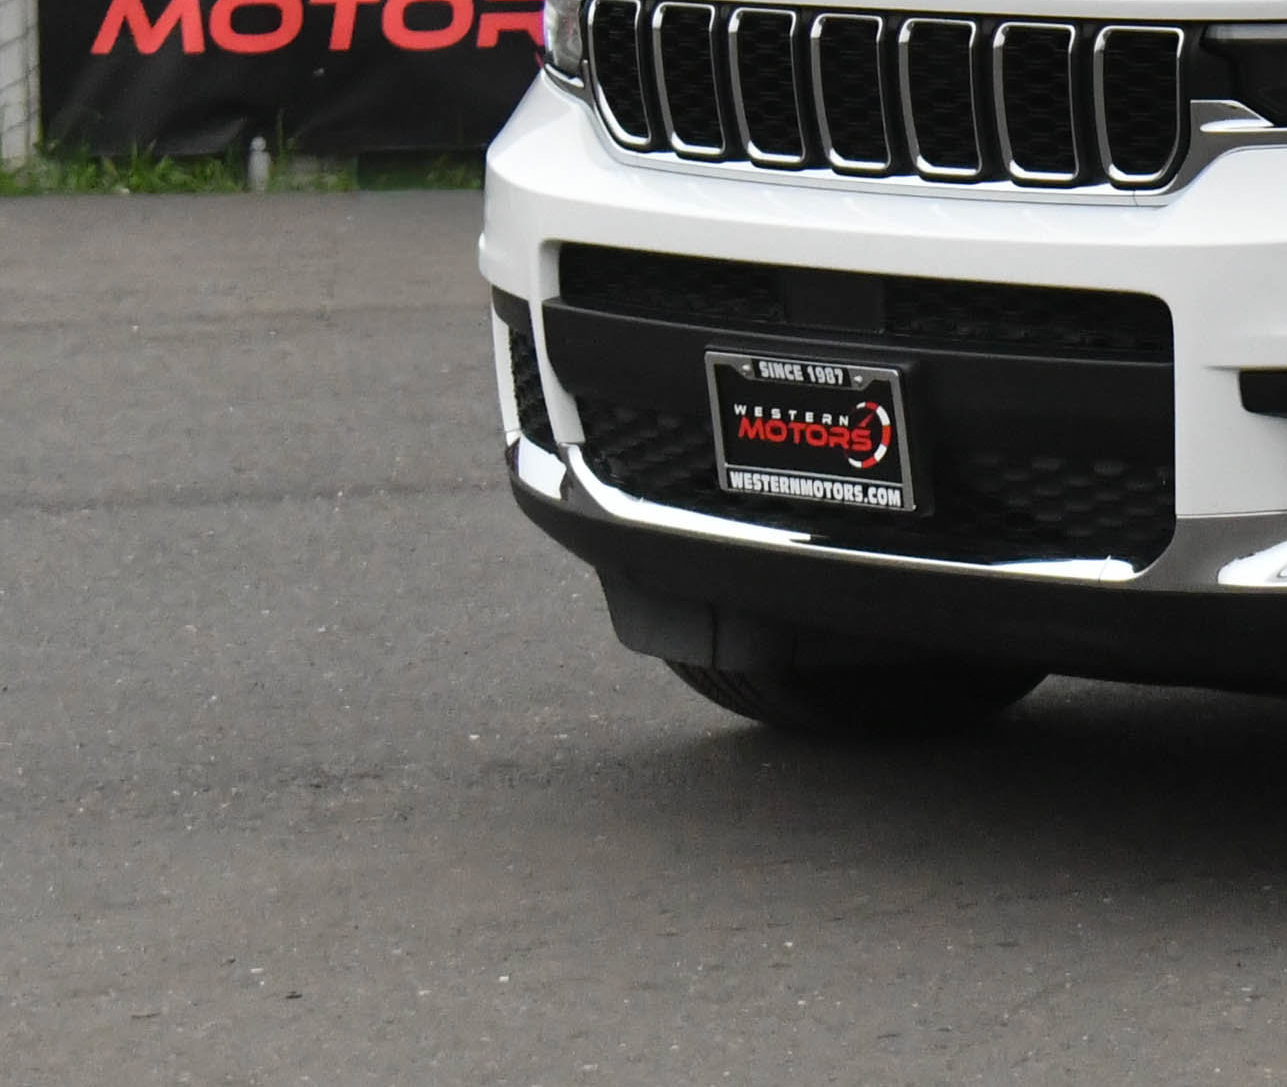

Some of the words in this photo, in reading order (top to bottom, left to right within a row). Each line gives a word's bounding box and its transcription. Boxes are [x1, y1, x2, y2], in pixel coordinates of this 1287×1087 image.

[758, 360, 805, 382] SINCE
[733, 403, 850, 426] WESTERN
[738, 416, 873, 451] MOTORS
[729, 470, 902, 507] WESTERNMOTORS.COM
